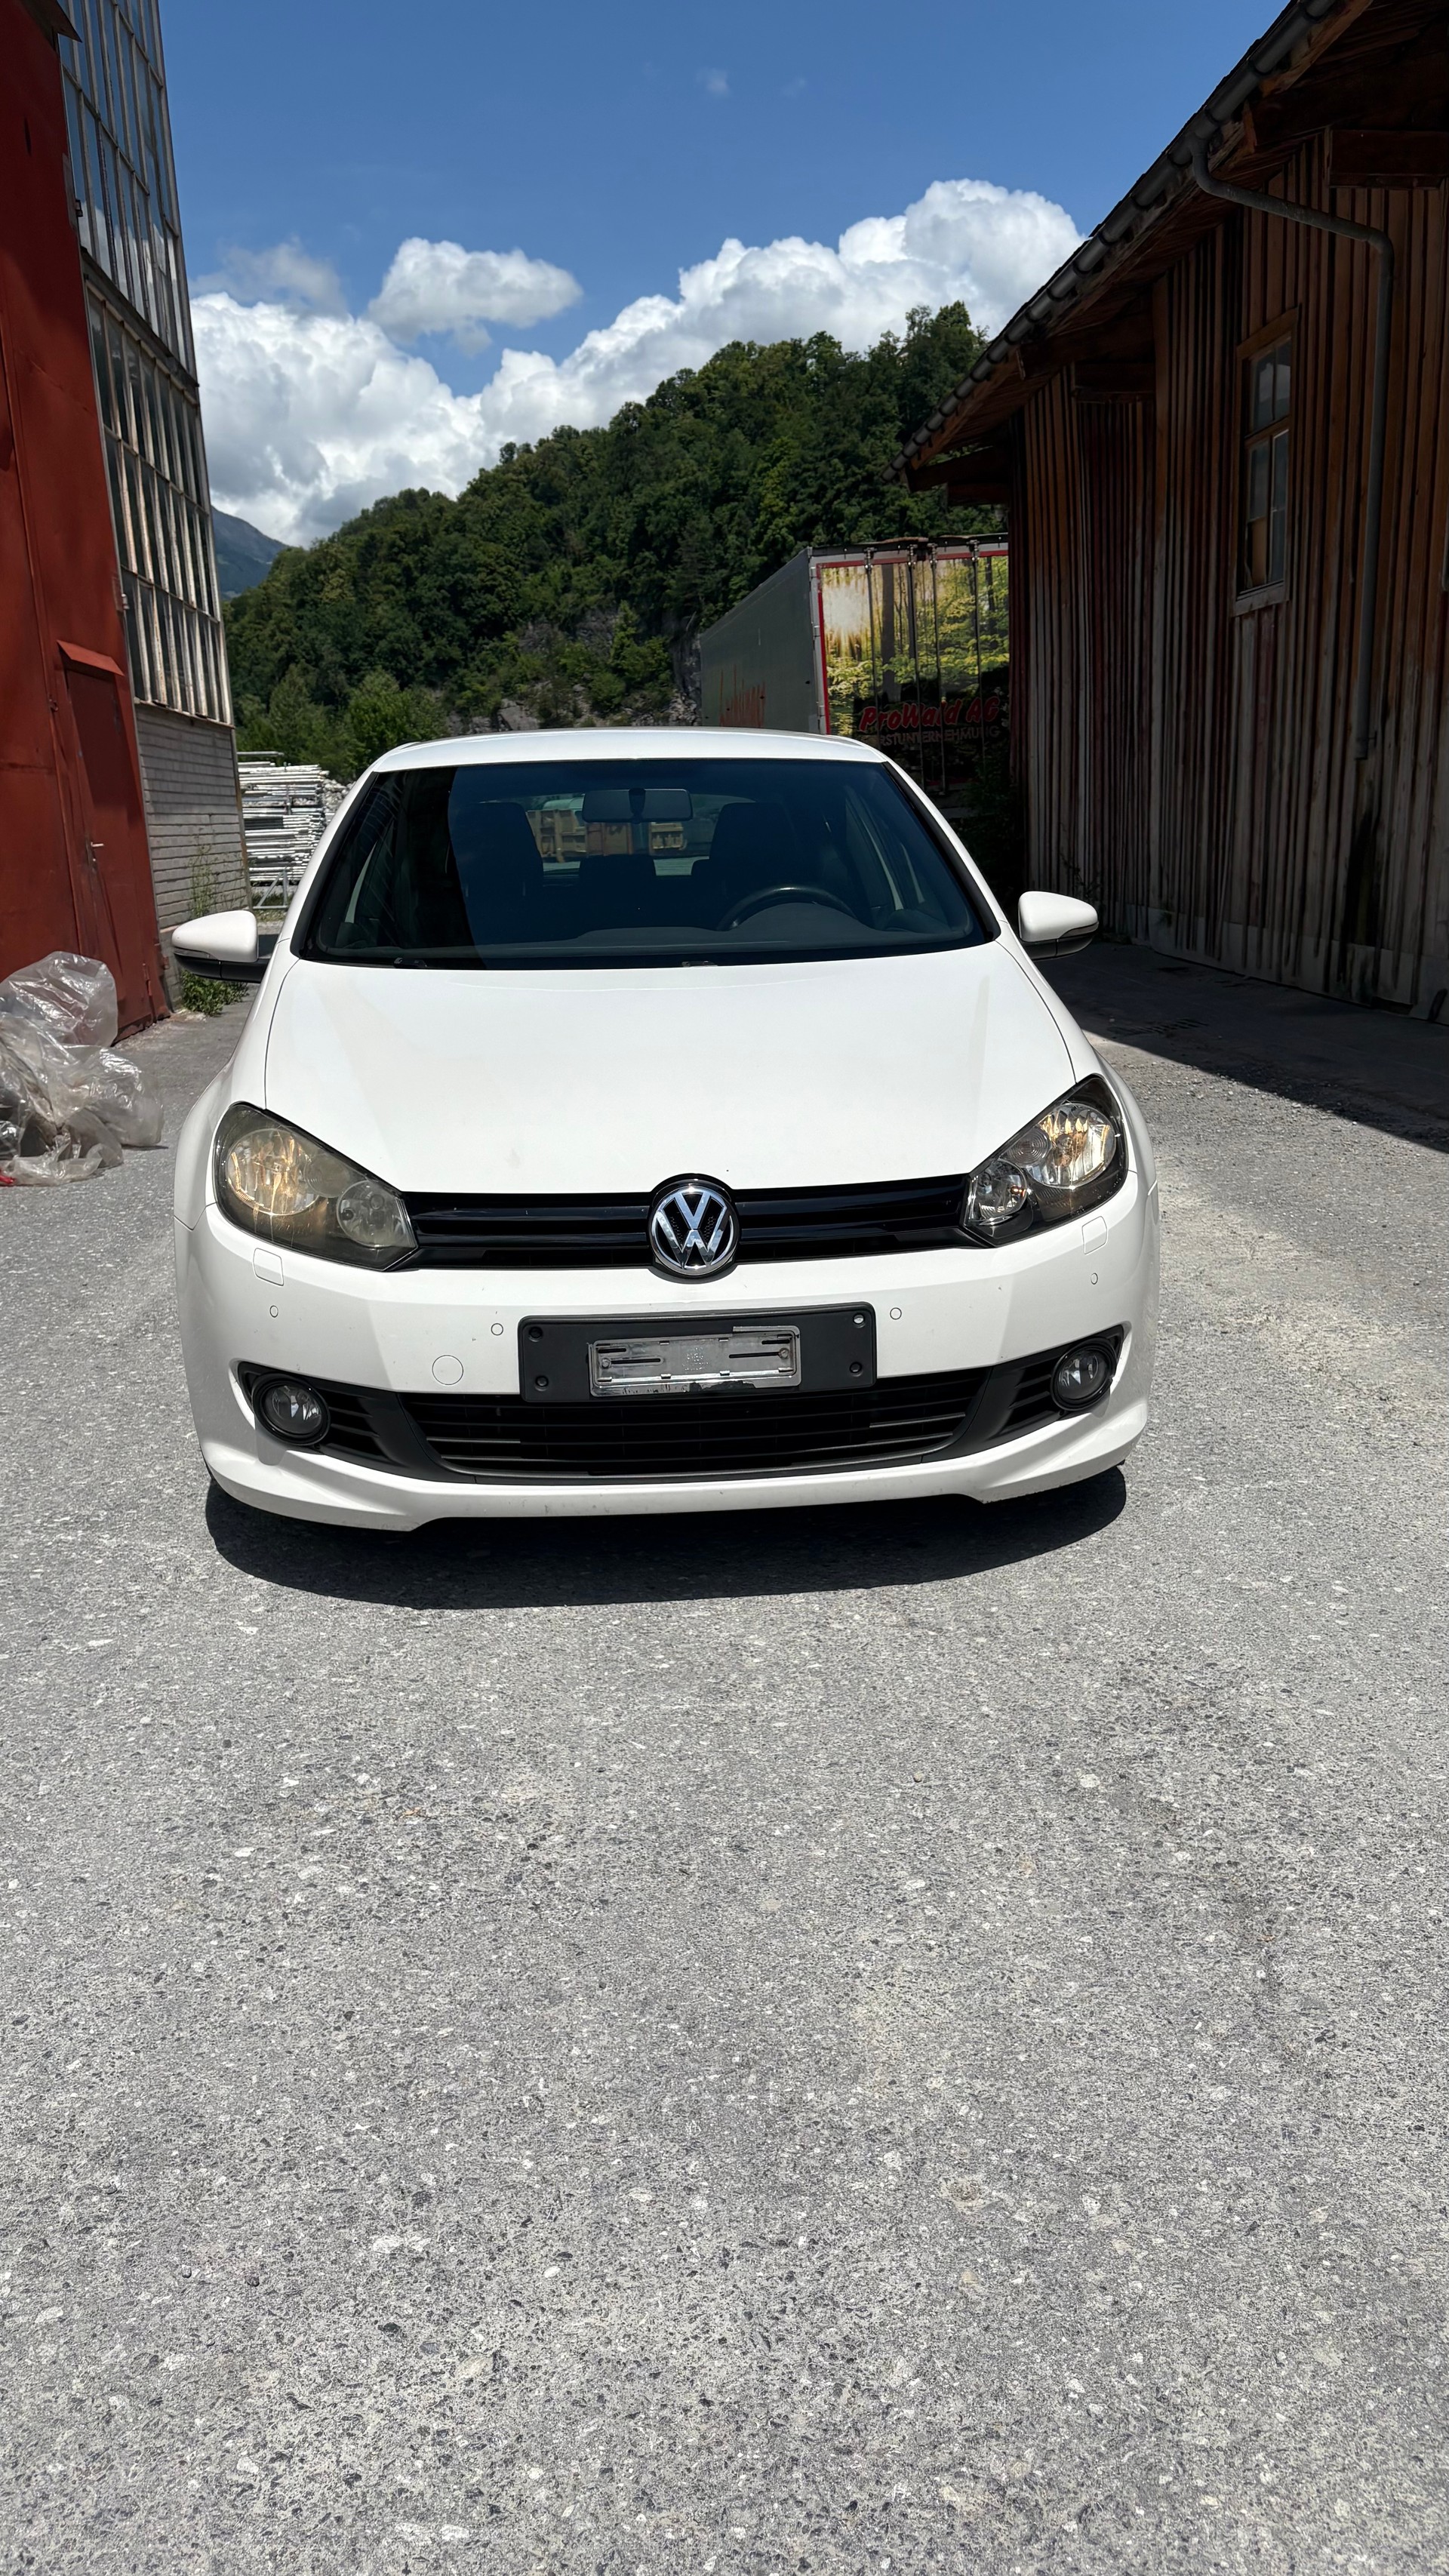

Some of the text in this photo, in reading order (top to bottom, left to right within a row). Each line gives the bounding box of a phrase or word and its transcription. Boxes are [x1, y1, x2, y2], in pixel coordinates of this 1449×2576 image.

[965, 695, 1001, 725] AG
[863, 725, 1001, 747] RSTUNTERNEHMUNG
[652, 1188, 734, 1271] VW
